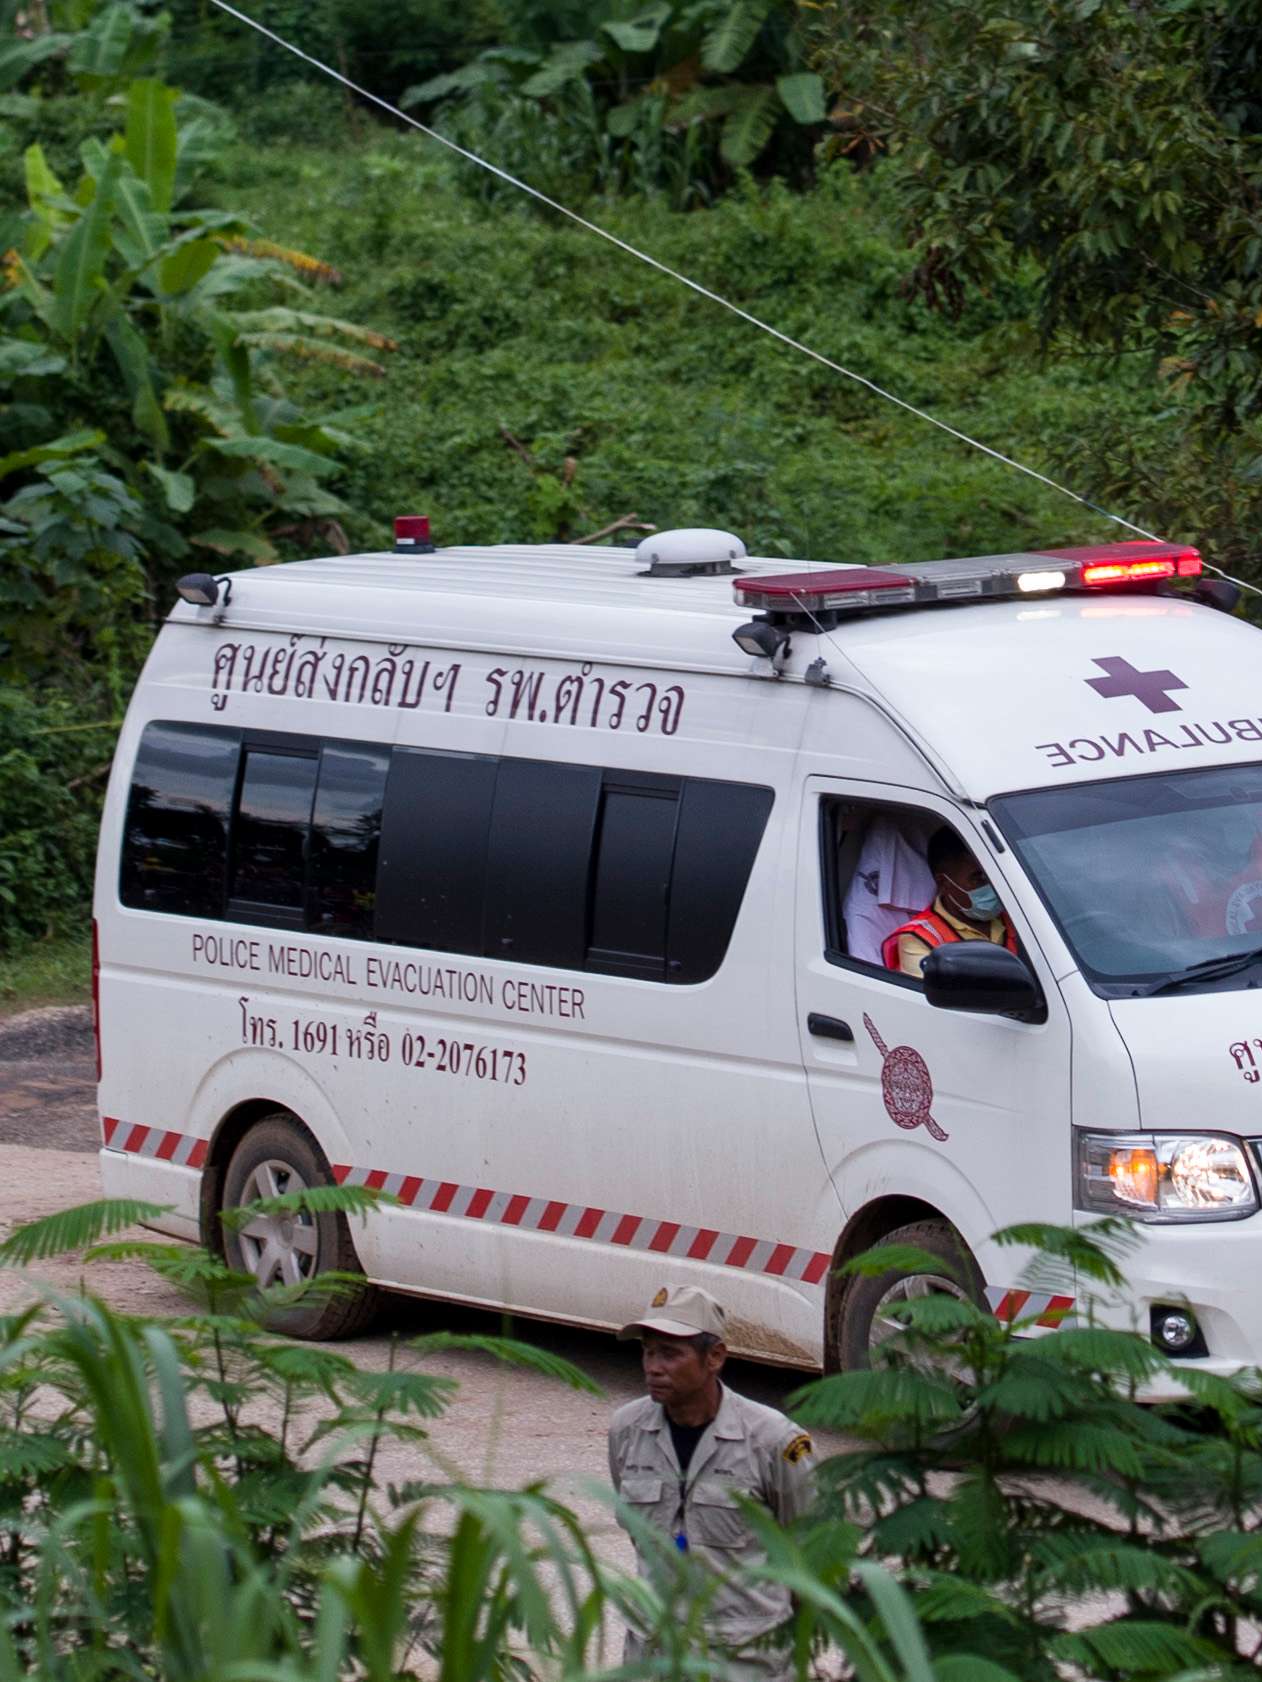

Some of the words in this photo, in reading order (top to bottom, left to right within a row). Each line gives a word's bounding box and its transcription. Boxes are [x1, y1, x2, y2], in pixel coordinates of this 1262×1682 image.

[211, 634, 461, 712] ศูนย์ส่งกลับฯ
[485, 661, 685, 735] รพ.ตำรวจ
[193, 934, 260, 971] POLICE
[269, 945, 357, 985] MEDICAL
[367, 957, 493, 1005] EVACUATION
[502, 980, 585, 1019] CENTER
[238, 996, 284, 1049] โทร.
[292, 1020, 338, 1056] 1691
[346, 1011, 391, 1063] หรือ
[401, 1033, 527, 1086] 02-2076173
